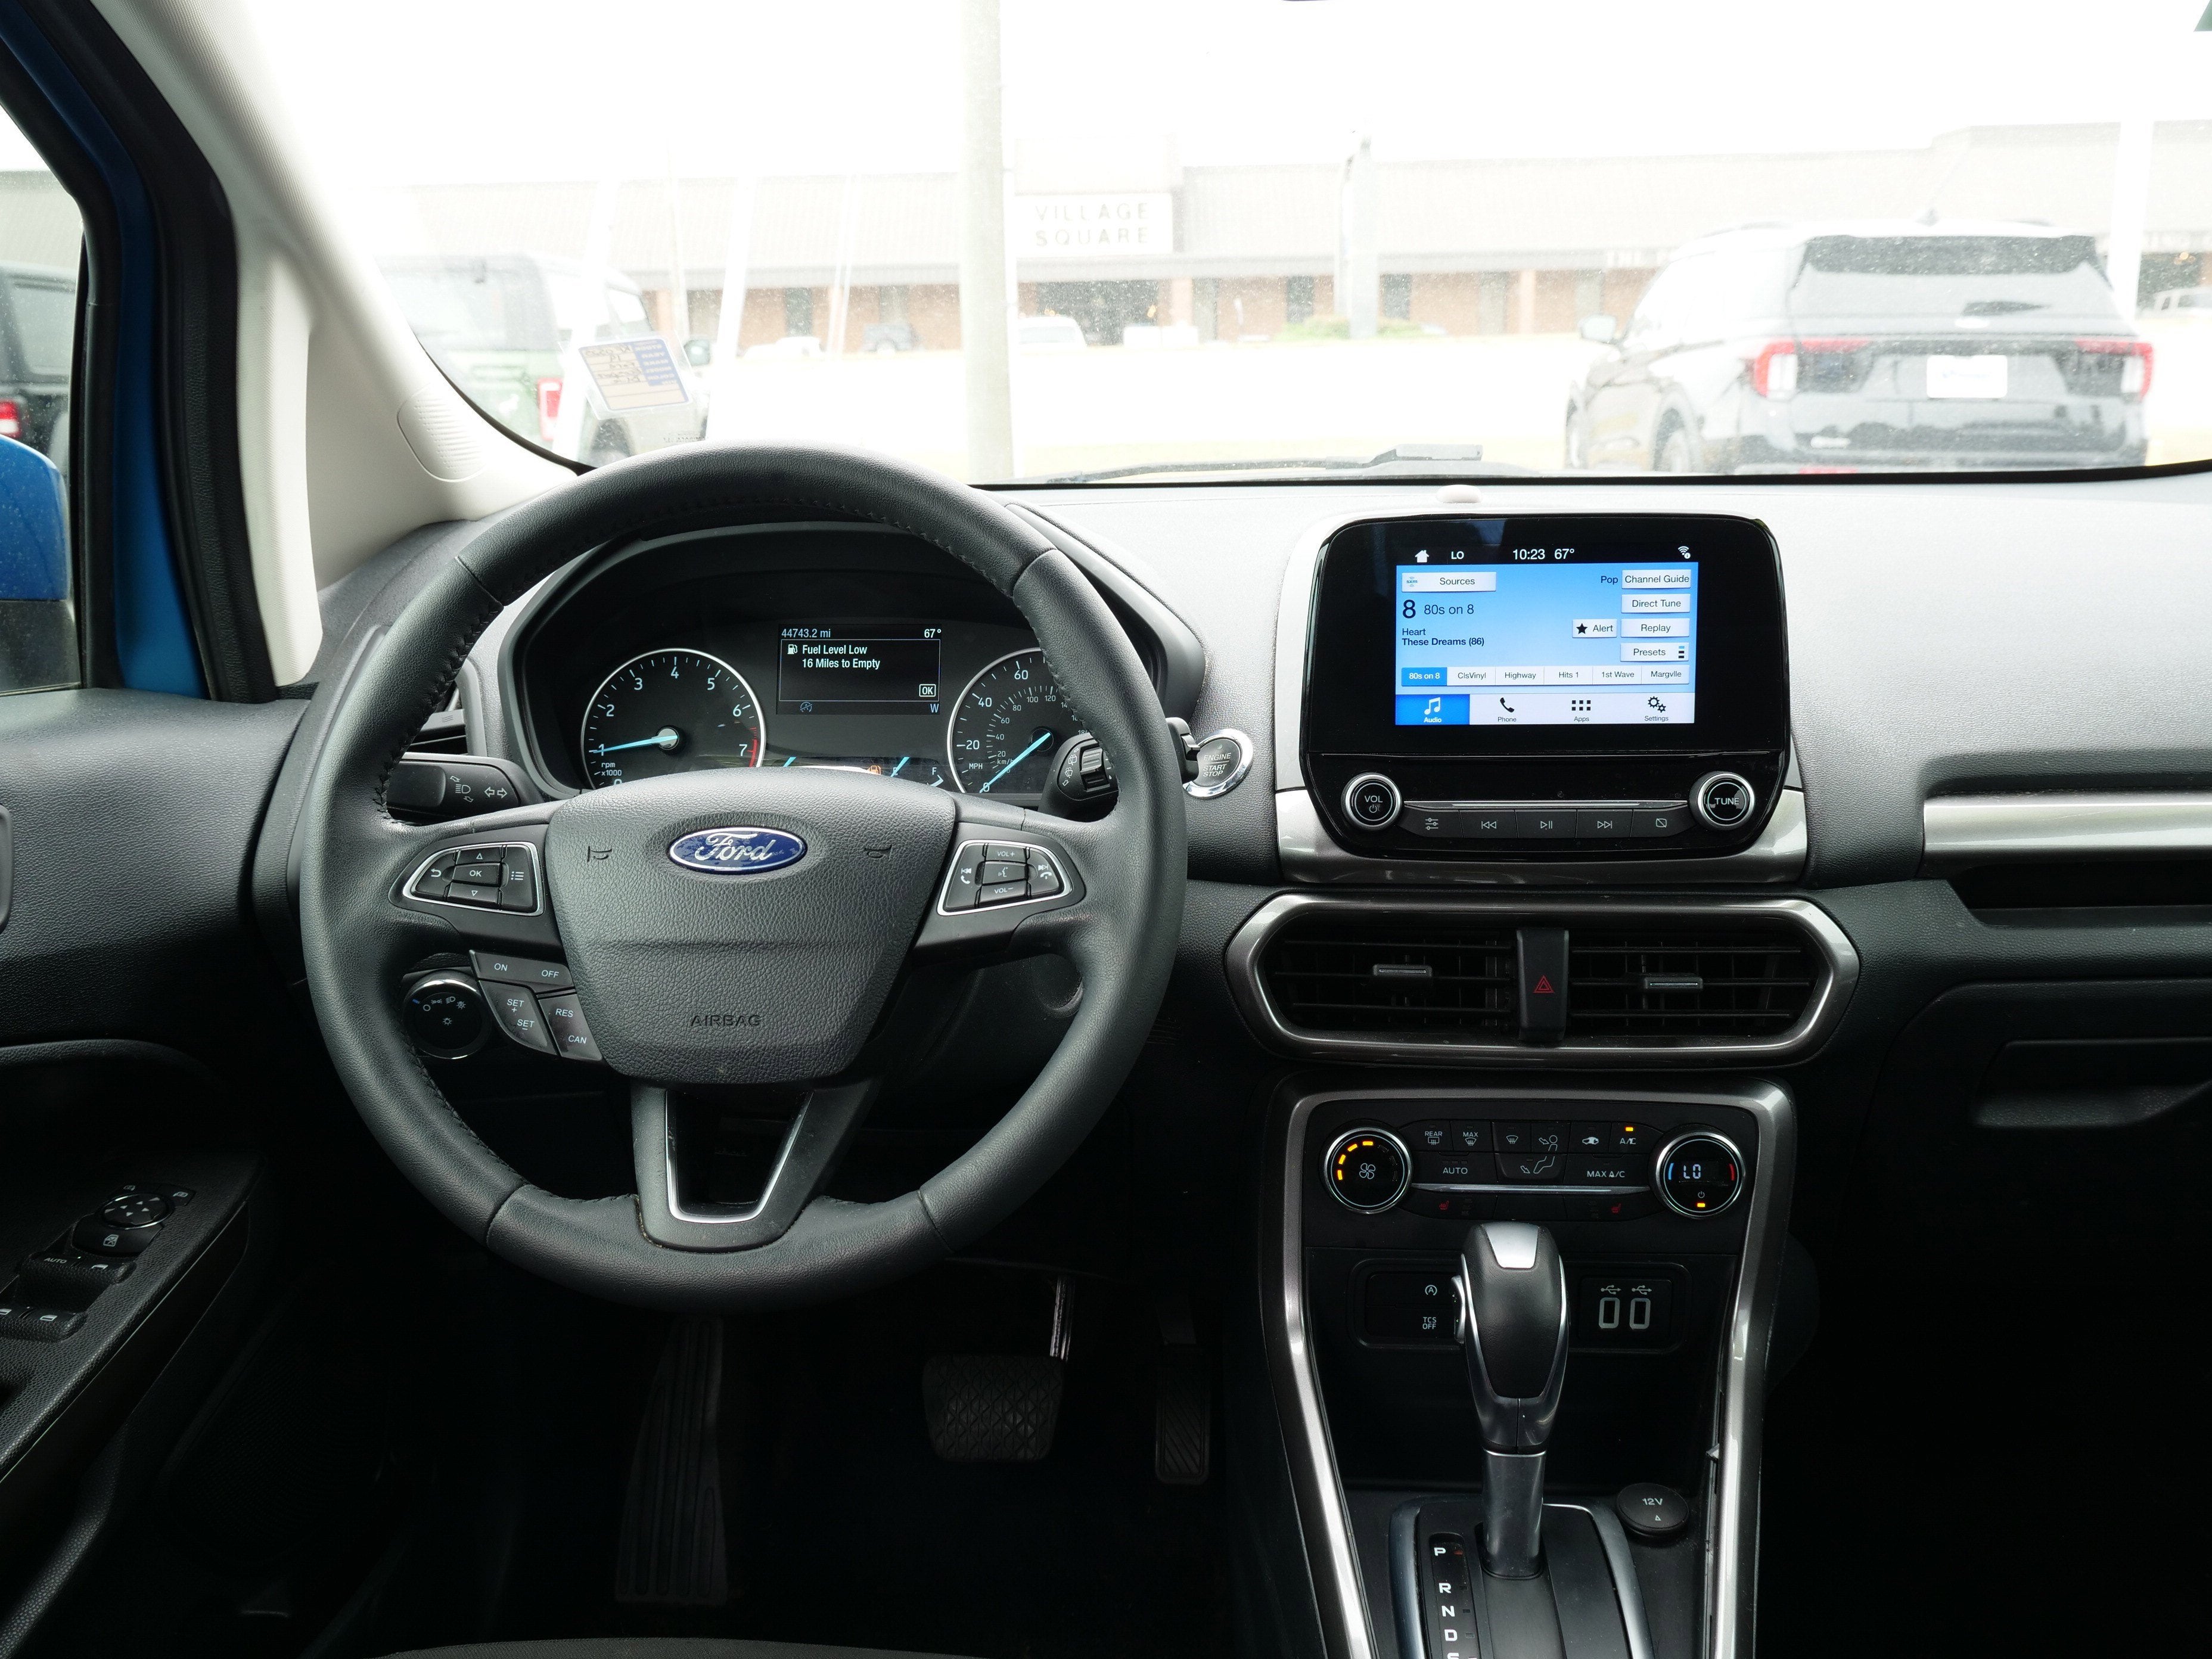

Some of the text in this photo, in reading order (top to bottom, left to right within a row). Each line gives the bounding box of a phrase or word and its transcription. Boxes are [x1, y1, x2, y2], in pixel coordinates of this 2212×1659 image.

[1034, 203, 1148, 221] VILLAGE
[1035, 228, 1148, 247] SQUARE
[1451, 548, 1575, 560] LO 10:23 67°
[1439, 577, 1475, 586] Sources
[1601, 576, 1618, 585] Pop
[1624, 575, 1661, 583] Channel
[1660, 599, 1682, 607] Tune
[1402, 599, 1474, 619] 8 80s on 8
[781, 628, 831, 638] 44743.2 mi
[924, 628, 942, 638] 67°
[1641, 624, 1671, 633] Replay
[1469, 637, 1484, 647] (86)
[802, 645, 868, 654] Fuel Level Low
[802, 658, 881, 670] 16 Miles to Empty
[670, 666, 679, 679] 4
[1014, 670, 1029, 680] 60
[1651, 670, 1682, 679] Margvlle
[633, 678, 643, 690] 3
[707, 678, 715, 690] 5
[922, 686, 933, 695] OK
[978, 697, 992, 707] 40
[606, 704, 614, 717] 2
[732, 704, 741, 717] 6
[930, 703, 939, 713] W
[598, 744, 604, 756] 1
[966, 740, 980, 750] 20
[739, 744, 748, 757] 7
[1203, 752, 1232, 761] ENGINE
[932, 767, 937, 775] F
[1364, 794, 1383, 803] VOL
[1714, 797, 1740, 805] TUNE
[694, 832, 776, 861] Ford
[493, 963, 508, 971] ON
[541, 970, 560, 978] OFF
[507, 998, 524, 1007] SET
[555, 1008, 574, 1018] RES
[517, 1019, 535, 1028] SET
[691, 1014, 762, 1027] AIRBAG
[568, 1035, 587, 1044] CAN
[1683, 1164, 1701, 1179] LO
[1642, 1498, 1664, 1506] 12V
[1434, 1547, 1446, 1557] P
[1439, 1583, 1452, 1594] R
[1441, 1605, 1455, 1617] N
[1444, 1629, 1458, 1642] D
